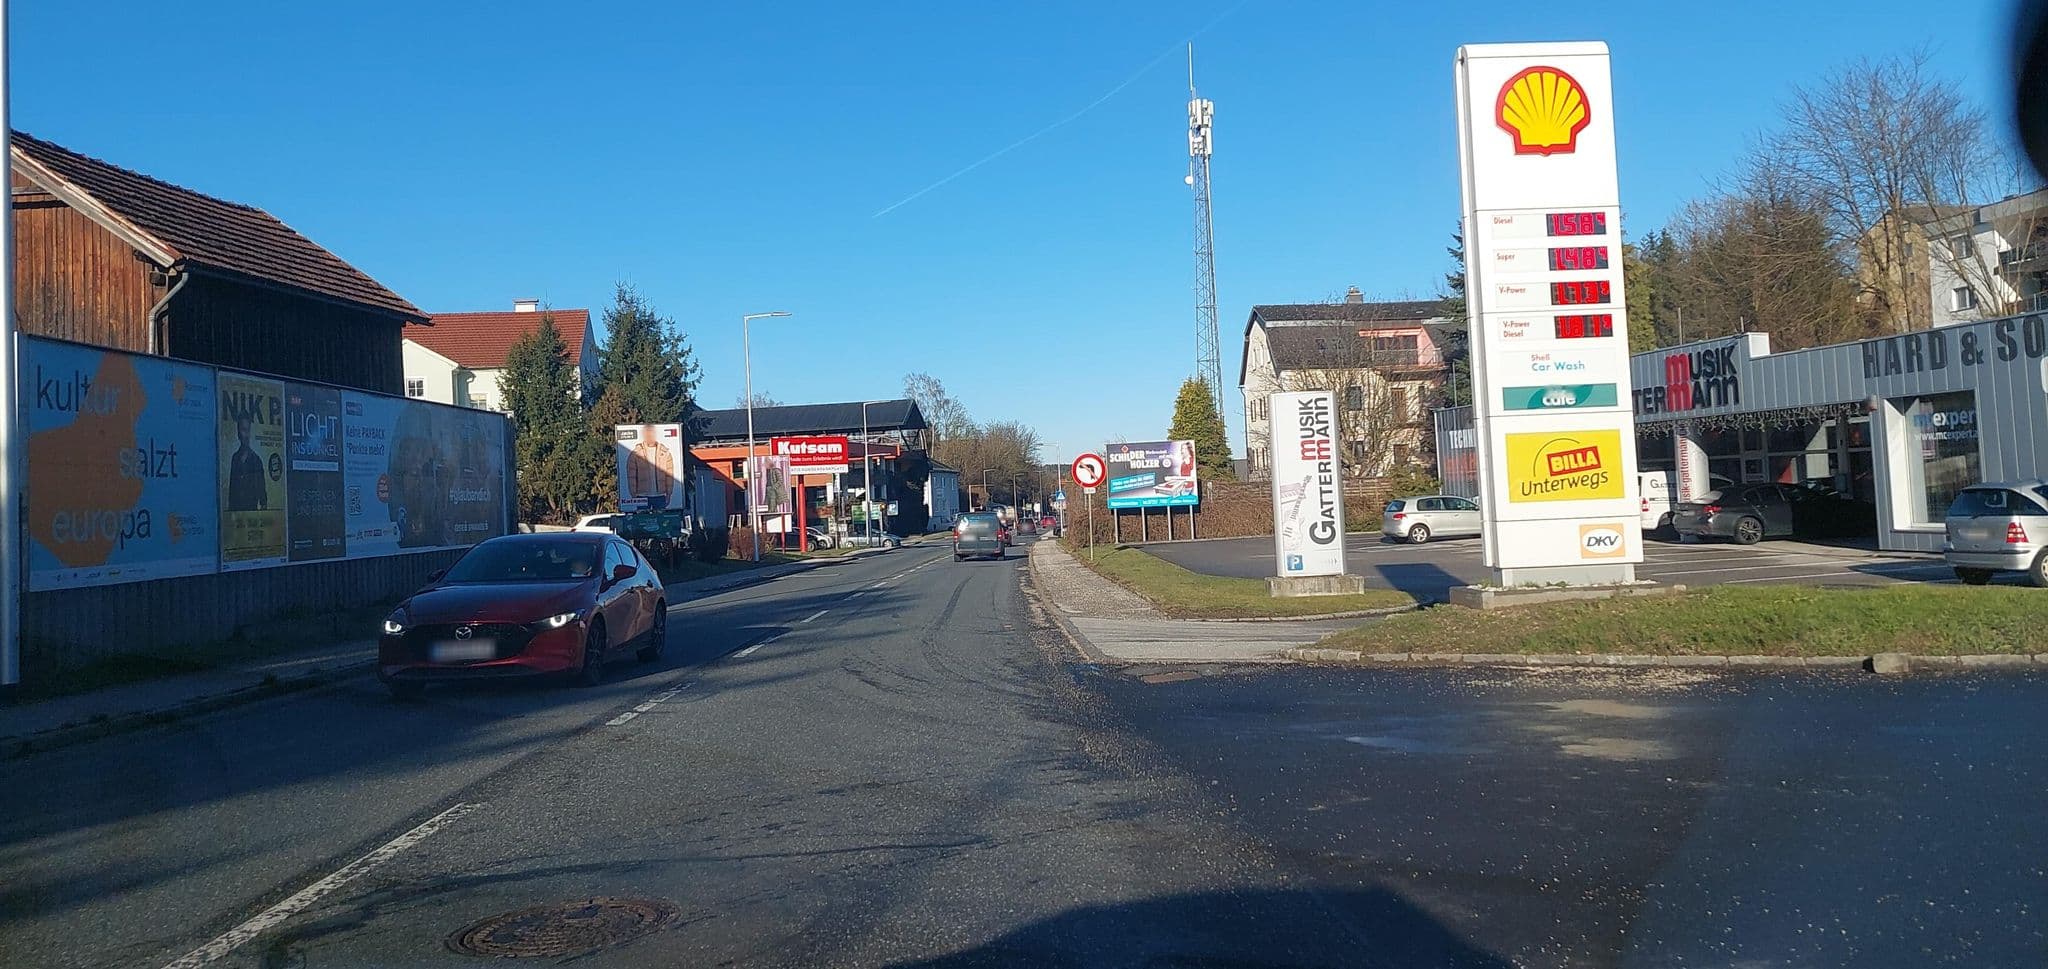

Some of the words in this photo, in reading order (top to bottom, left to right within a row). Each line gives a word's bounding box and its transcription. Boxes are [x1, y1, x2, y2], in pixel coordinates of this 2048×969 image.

[1493, 216, 1513, 225] Diesel
[1496, 252, 1515, 262] Super
[1499, 286, 1526, 294] V-Power
[1502, 320, 1530, 328] V-Power
[1503, 329, 1524, 338] Diesel
[1531, 353, 1551, 361] Shell
[1862, 331, 1948, 378] HARD
[1961, 331, 1984, 366] &
[1531, 363, 1551, 372] Car
[1554, 360, 1585, 371] Wash
[36, 363, 122, 417] kultur
[291, 411, 338, 440] LICHT
[778, 441, 842, 455] Kutsam
[119, 436, 178, 480] salzt
[1109, 450, 1146, 463] SCHILDER
[1550, 450, 1598, 472] BILLA
[1130, 459, 1161, 469] HOLZER
[1521, 471, 1609, 497] Unterwegs
[52, 508, 152, 552] europa
[1586, 535, 1619, 547] DKV
